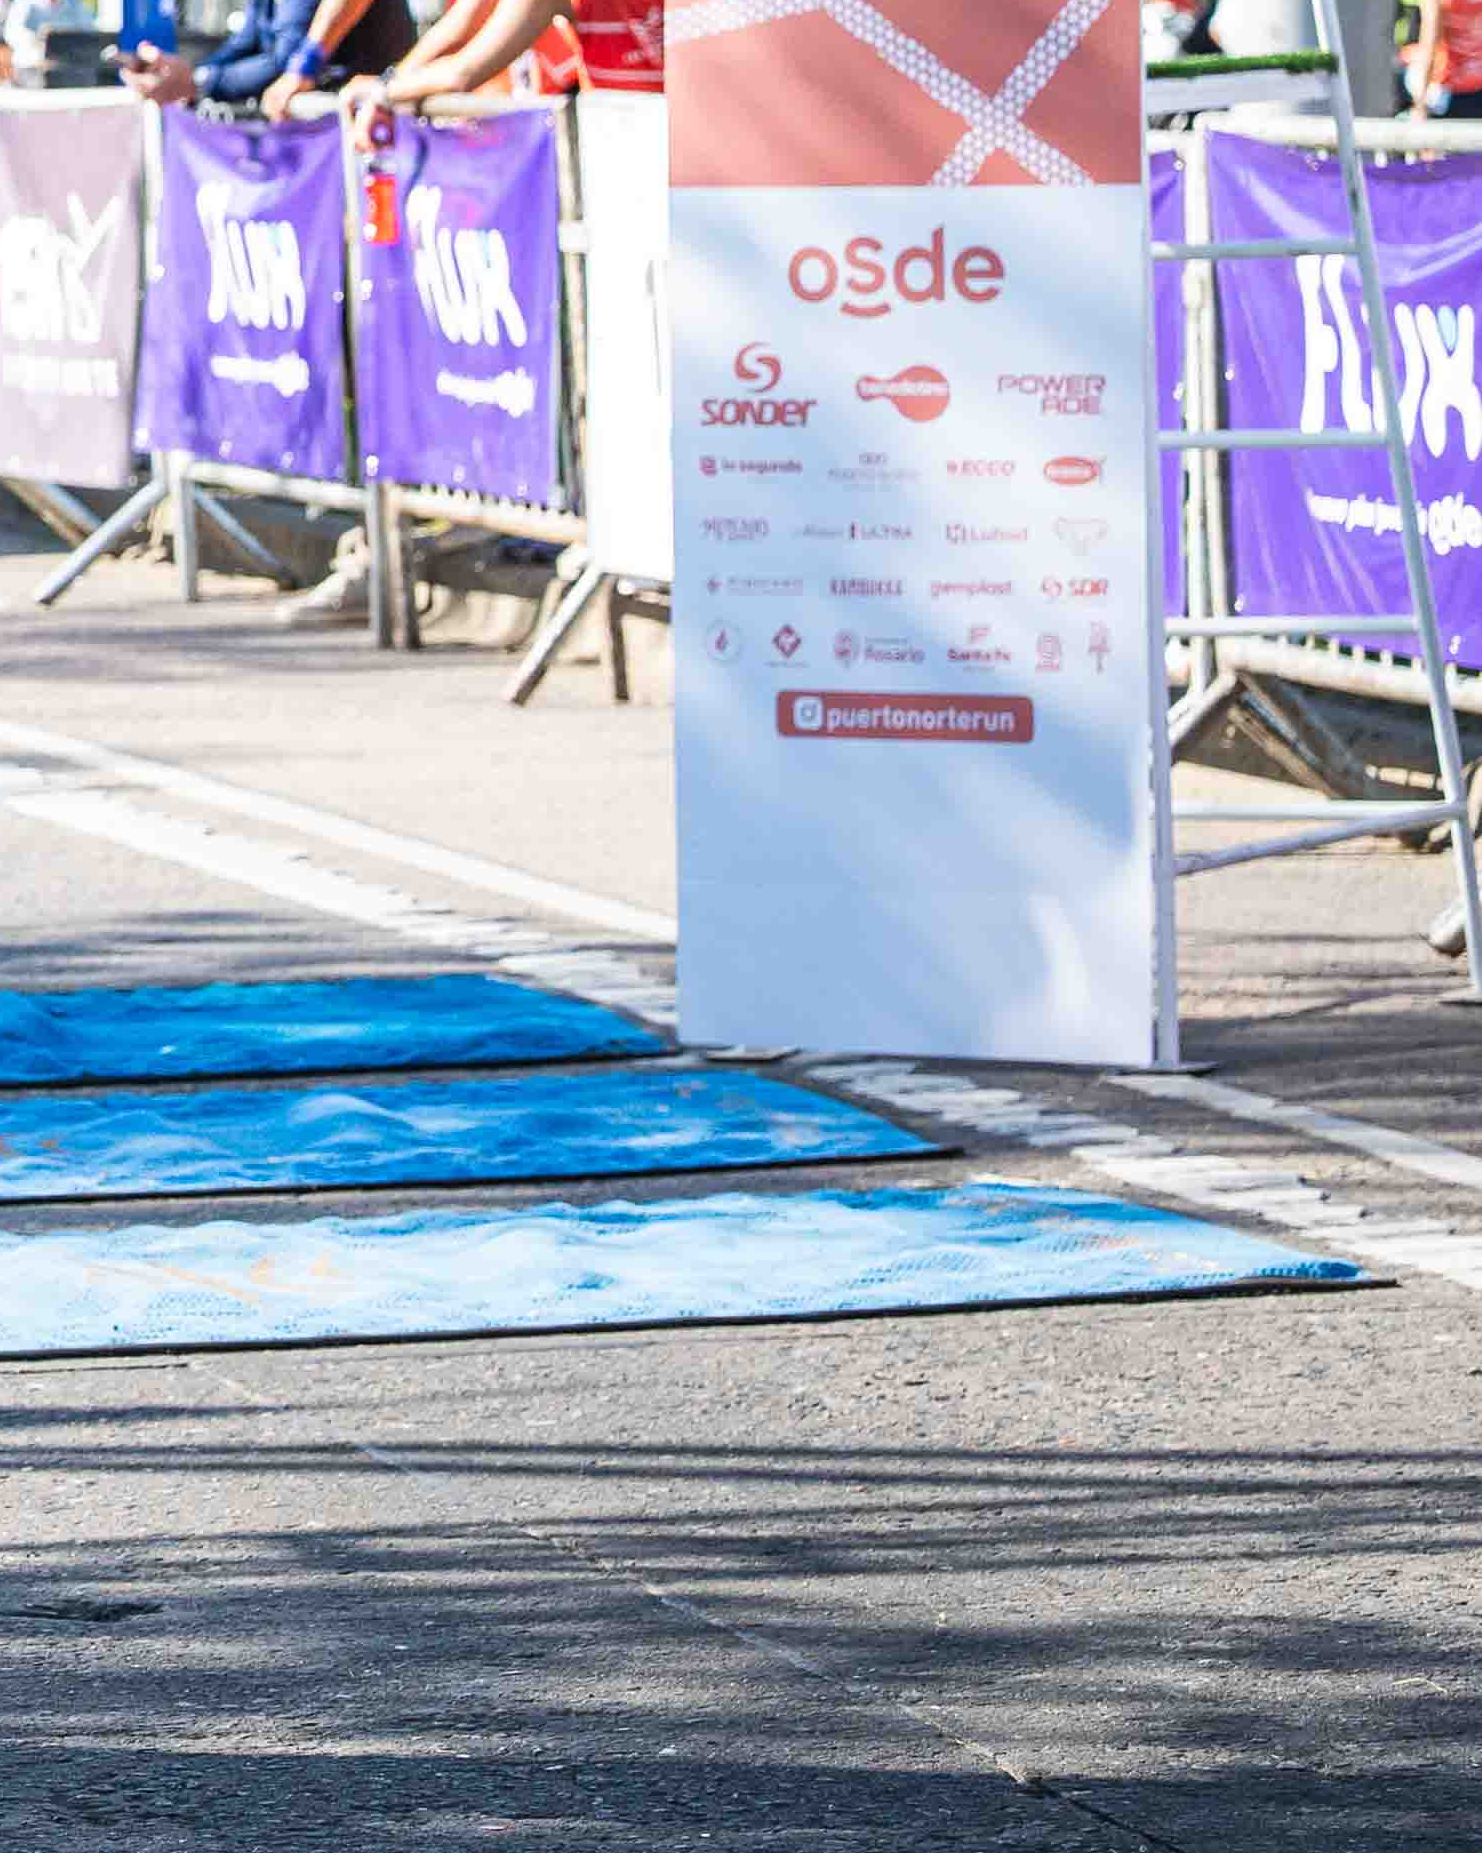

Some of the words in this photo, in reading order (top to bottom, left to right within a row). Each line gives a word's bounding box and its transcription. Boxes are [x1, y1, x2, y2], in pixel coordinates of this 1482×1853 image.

[788, 224, 1005, 310] osde
[997, 373, 1107, 396] POWER
[825, 703, 1015, 733] puertonorterun
